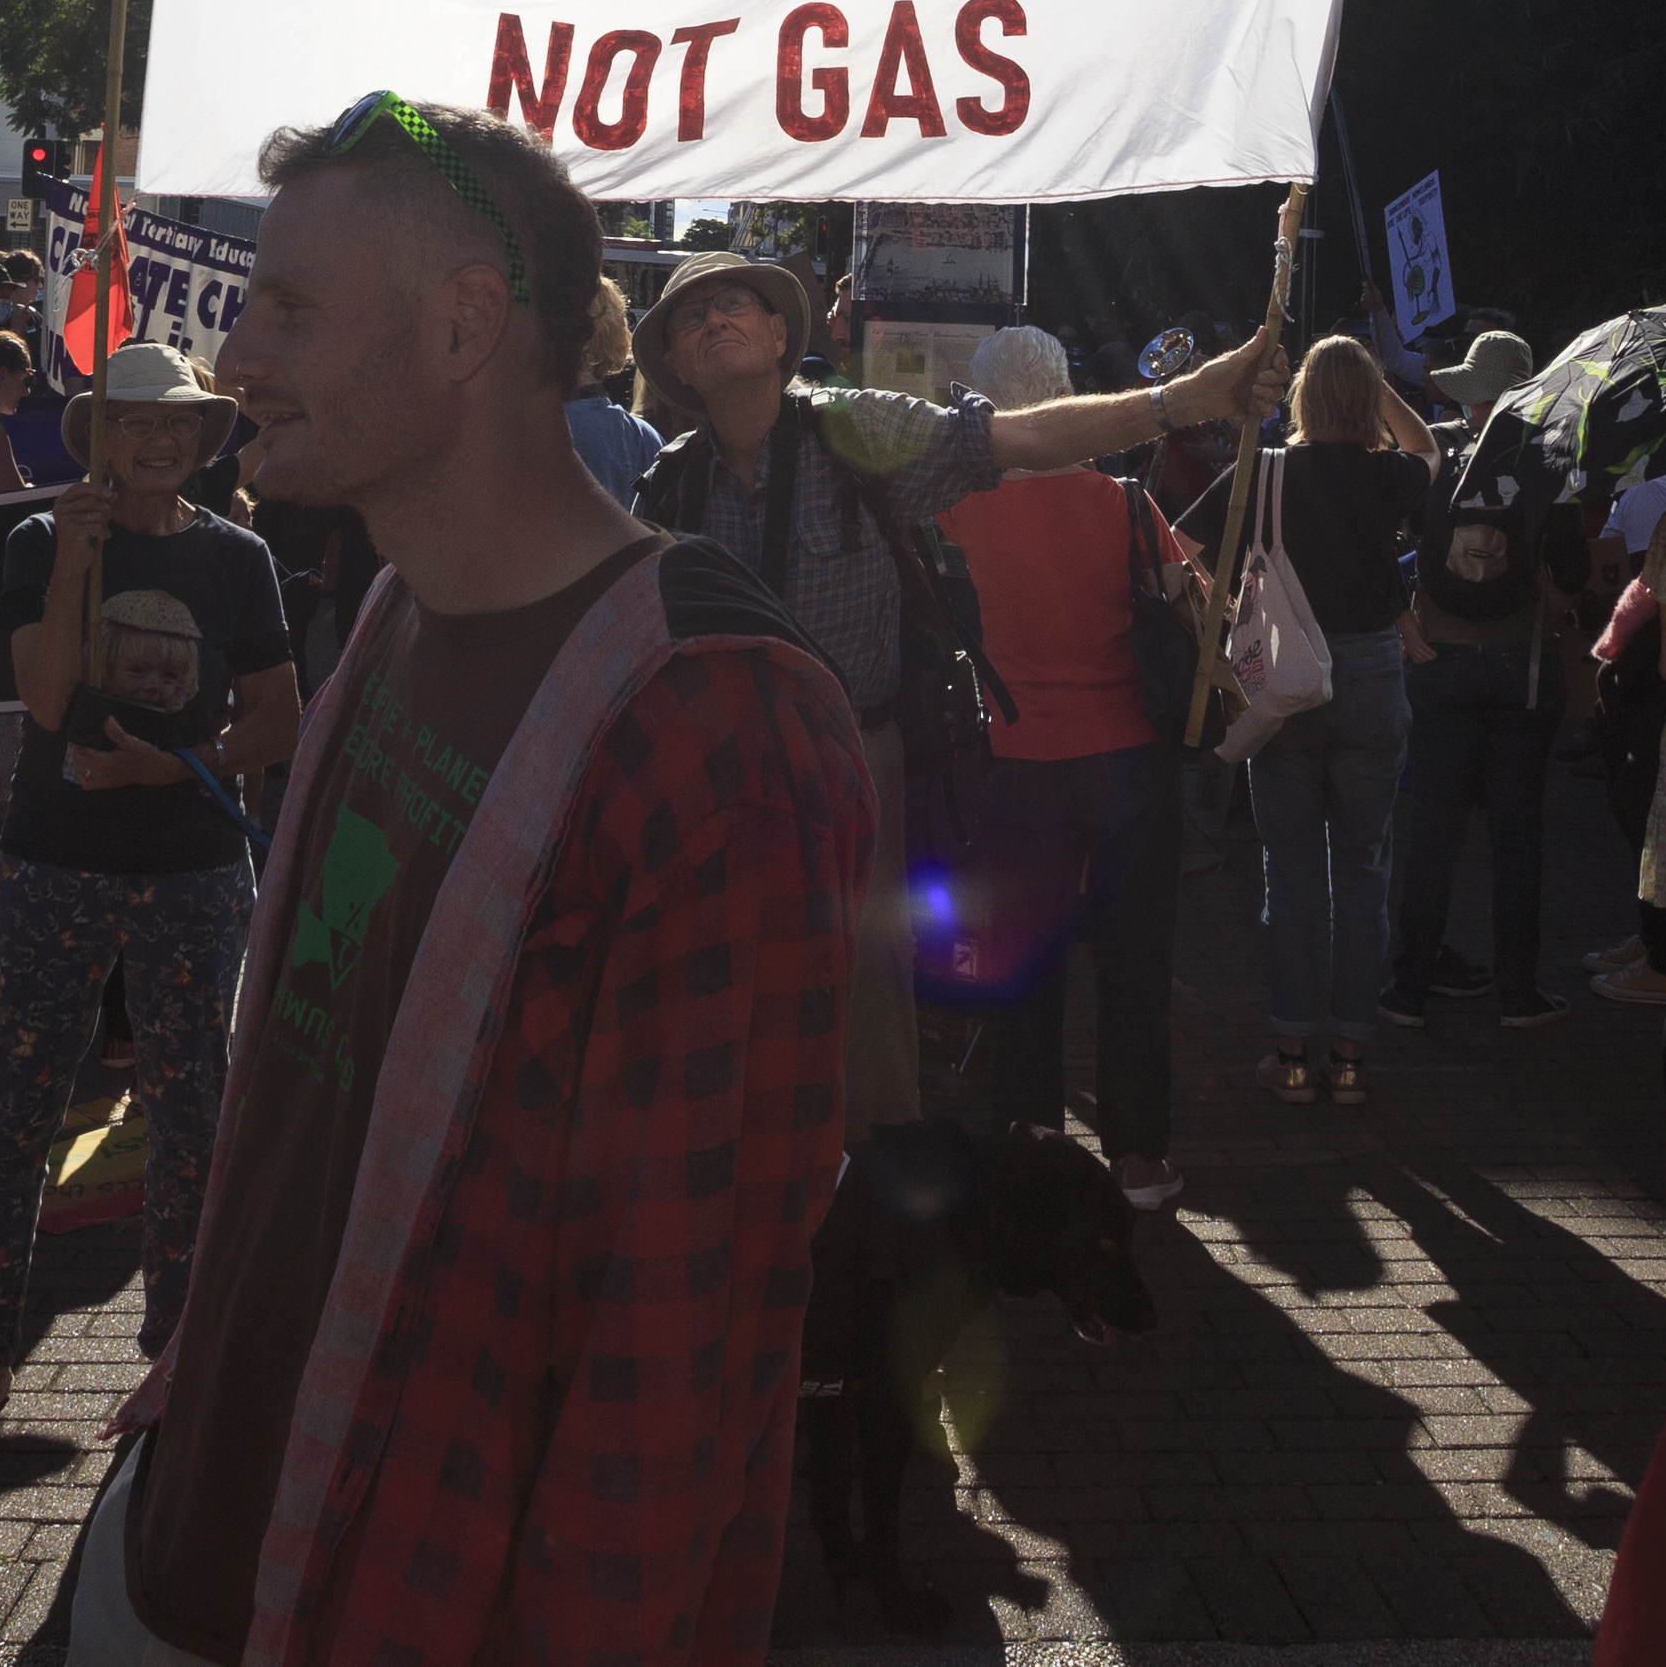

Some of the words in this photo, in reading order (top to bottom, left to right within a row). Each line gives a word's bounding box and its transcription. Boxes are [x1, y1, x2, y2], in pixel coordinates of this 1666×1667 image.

[486, 13, 740, 152] NOT
[10, 211, 30, 220] WAY
[11, 201, 29, 210] ONE
[140, 217, 204, 259] Tertiary
[208, 238, 256, 268] Educa
[413, 724, 490, 805] PLANE
